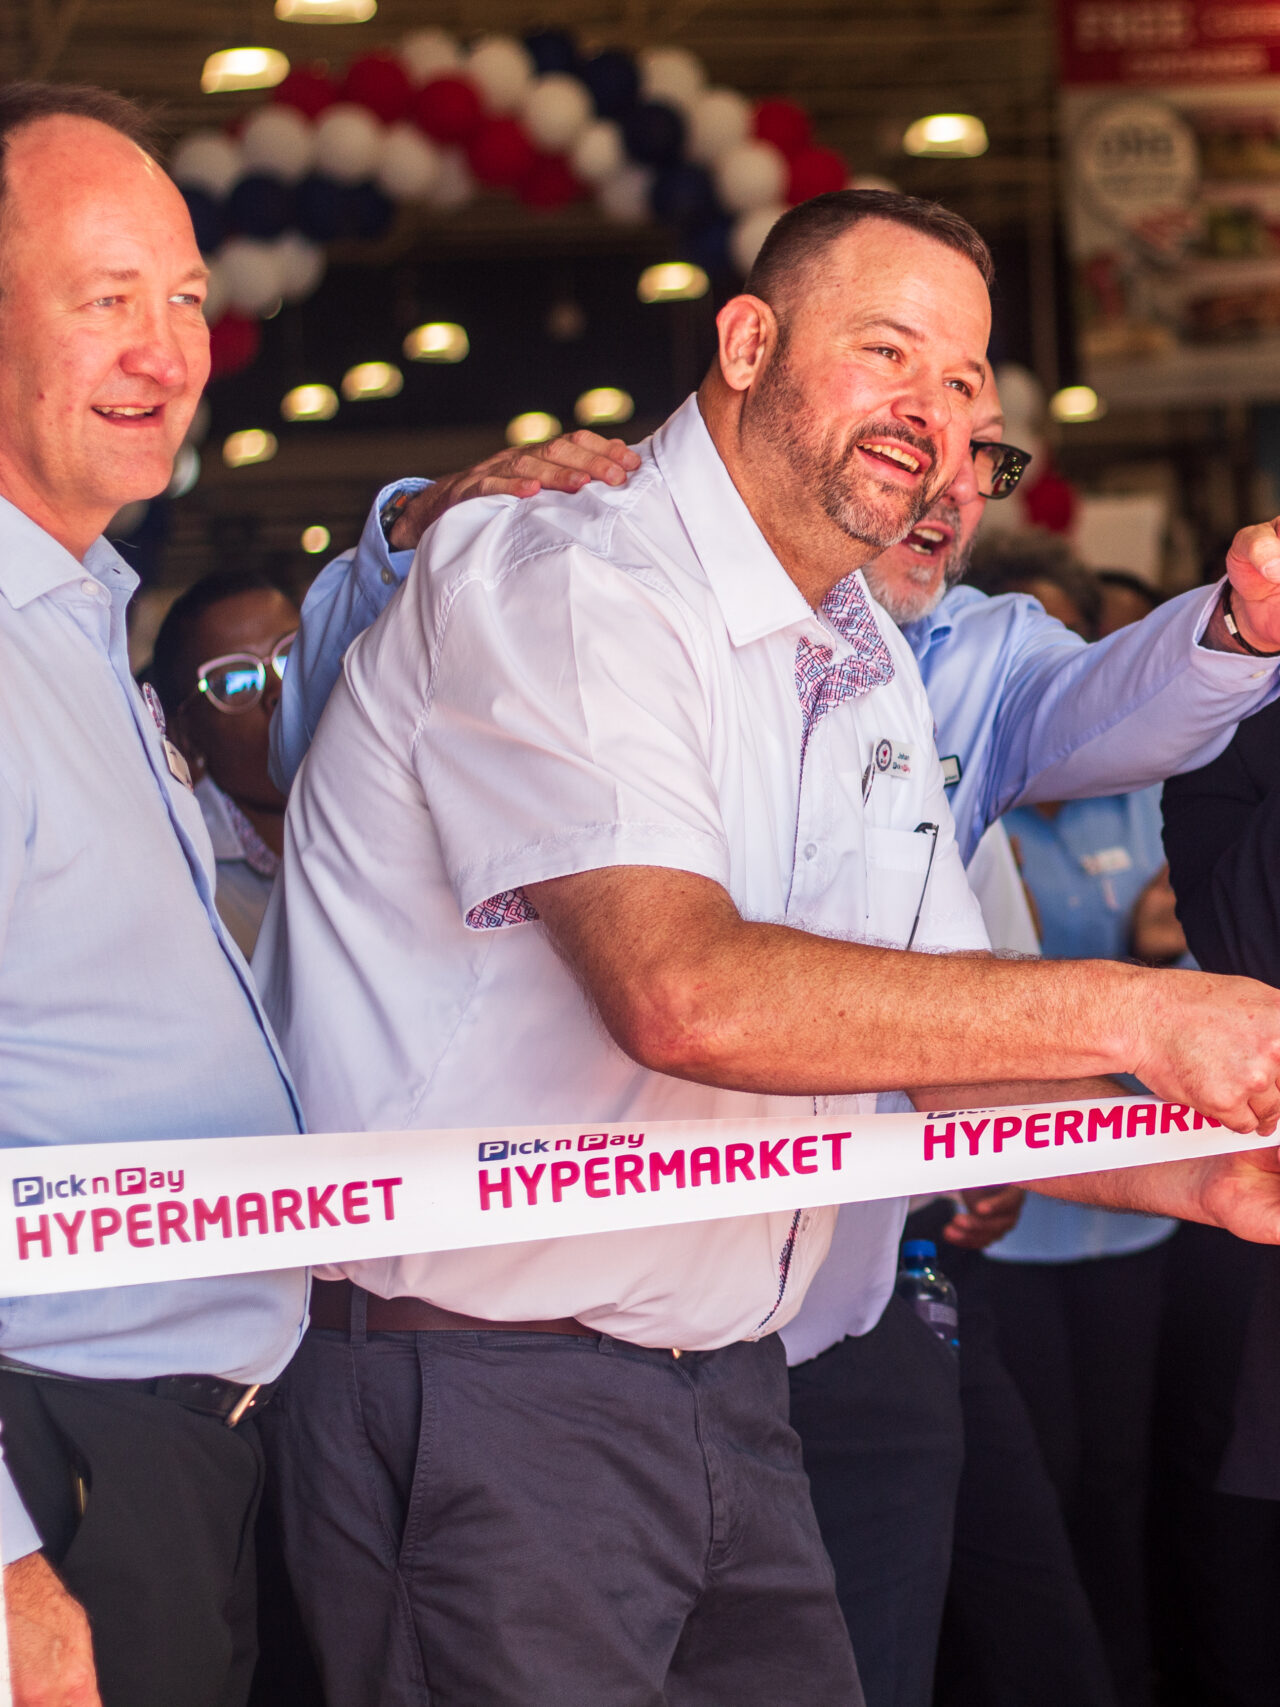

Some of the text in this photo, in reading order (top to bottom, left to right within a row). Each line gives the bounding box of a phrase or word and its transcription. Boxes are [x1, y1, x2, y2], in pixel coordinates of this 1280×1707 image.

[478, 1133, 645, 1162] Pick n Pay
[478, 1131, 852, 1211] HYPERMARKET
[13, 1167, 185, 1207] Pick n Pay
[15, 1177, 403, 1260] HYPERMARKET
